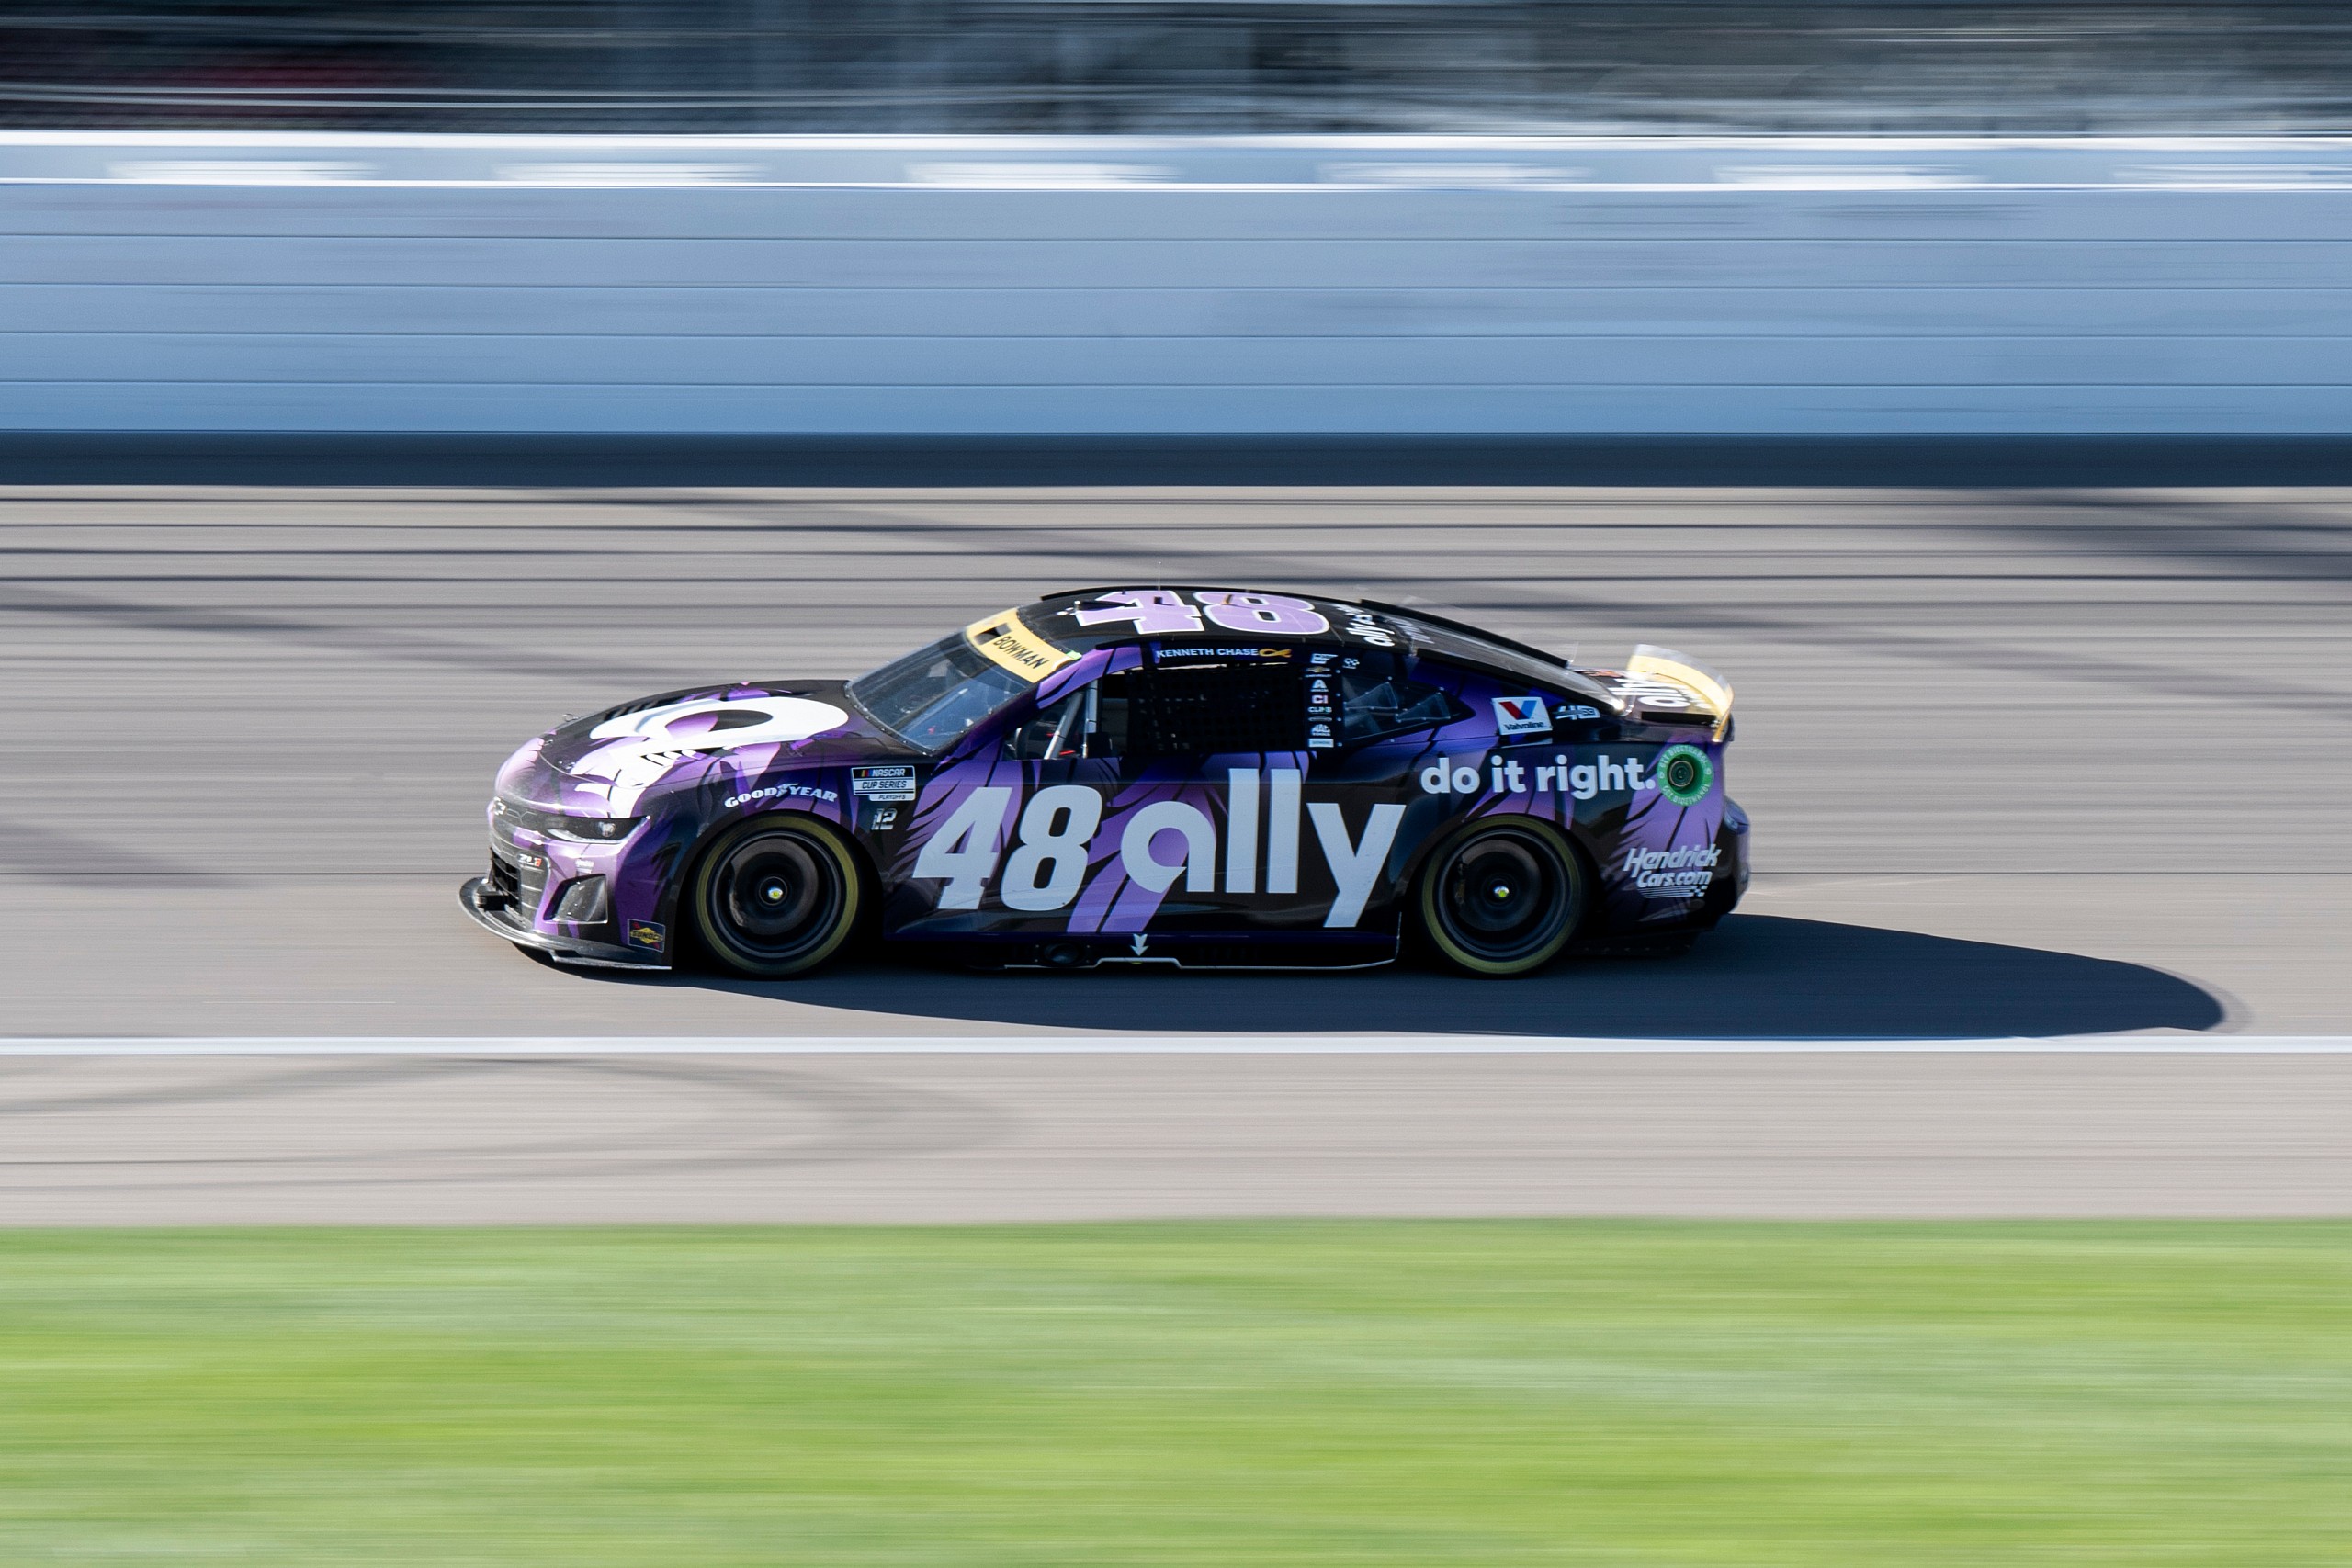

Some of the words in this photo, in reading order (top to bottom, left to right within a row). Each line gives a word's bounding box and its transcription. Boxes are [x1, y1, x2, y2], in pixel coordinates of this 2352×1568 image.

[1075, 590, 1330, 635] 48
[993, 636, 1050, 669] BOWMAN
[1156, 648, 1214, 658] KENNETH
[1216, 648, 1259, 656] CHASE
[1504, 721, 1544, 731] Valvoline
[862, 781, 878, 789] CUP
[878, 780, 907, 789] SERIES
[872, 768, 906, 777] NASCAR
[1420, 757, 1481, 794] do
[1490, 755, 1527, 794] it
[1535, 754, 1657, 800] right.
[724, 783, 839, 808] GOODYEAR
[912, 784, 1103, 912] 48
[1120, 768, 1408, 928] ally
[1622, 843, 1723, 878] Hendrick
[1636, 870, 1713, 888] Cars.com
